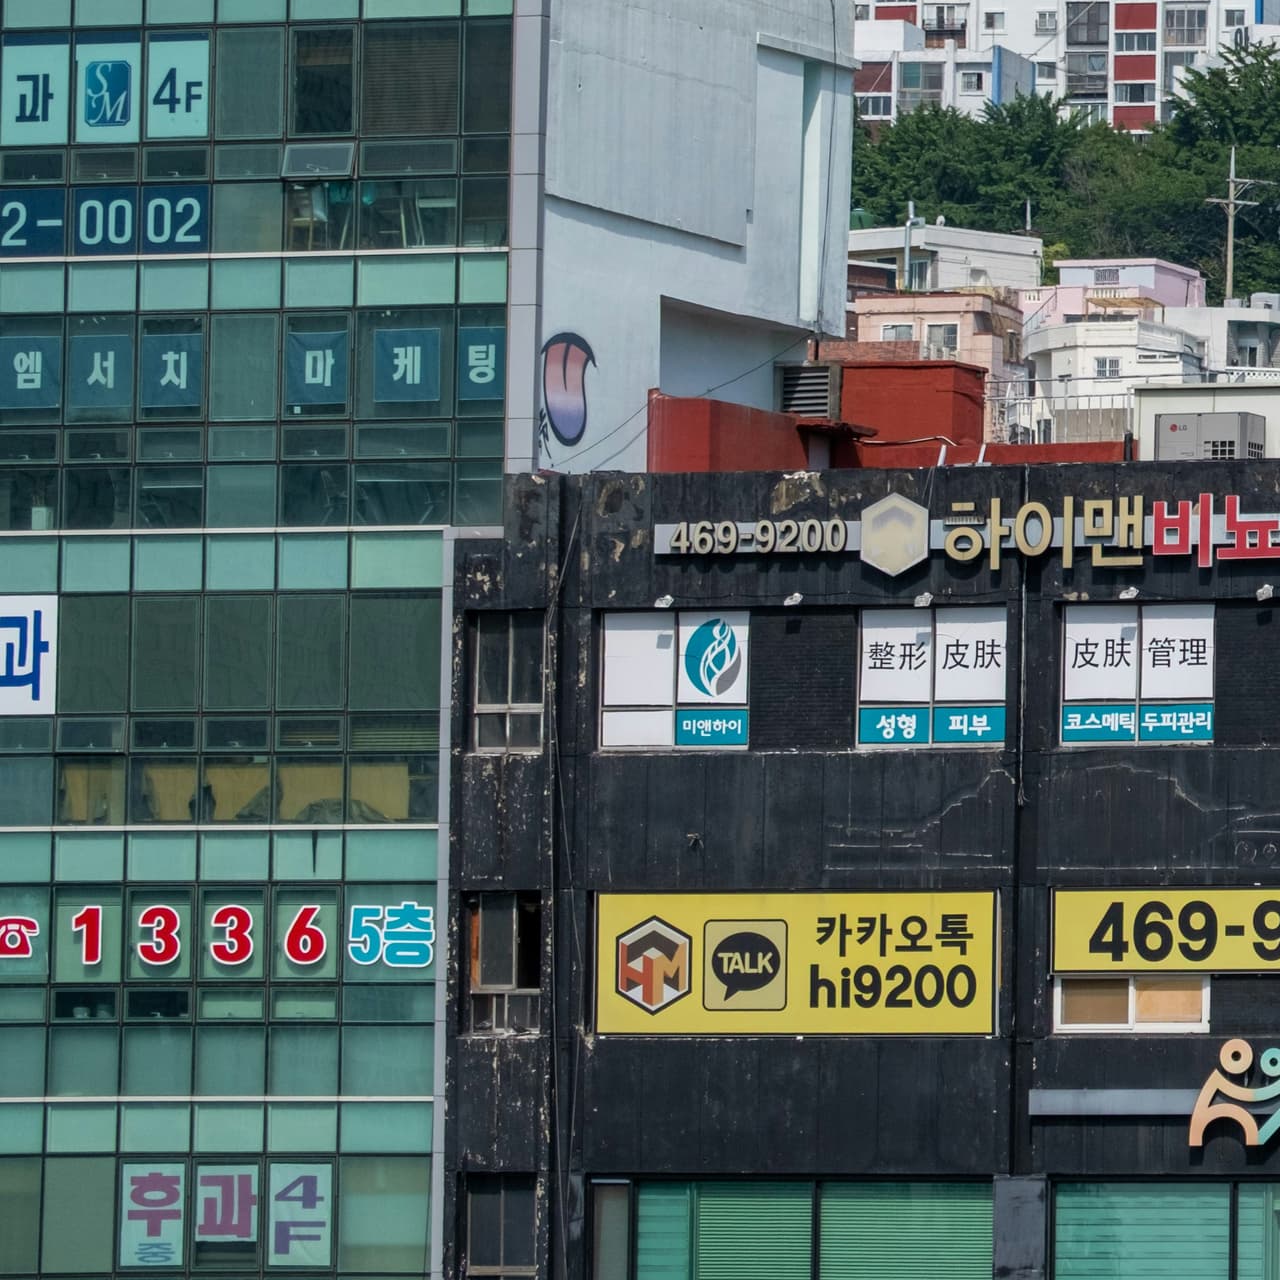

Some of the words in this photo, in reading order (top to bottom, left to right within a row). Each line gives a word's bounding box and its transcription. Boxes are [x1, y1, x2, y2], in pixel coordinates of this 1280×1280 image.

[15, 73, 54, 123] 과
[152, 67, 204, 114] 4F
[304, 342, 497, 388] 마케팅
[670, 519, 848, 555] 469-9200
[682, 718, 743, 738] 미앤하이
[876, 713, 918, 740] 성형
[948, 713, 991, 737] 피부
[1063, 711, 1137, 735] 코스메틱
[1140, 710, 1213, 734] 두피관리
[72, 904, 327, 966] 1336
[347, 901, 436, 968] 5층
[815, 913, 975, 958] 카카오톡
[717, 951, 775, 976] TALK
[808, 963, 978, 1009] hi9200
